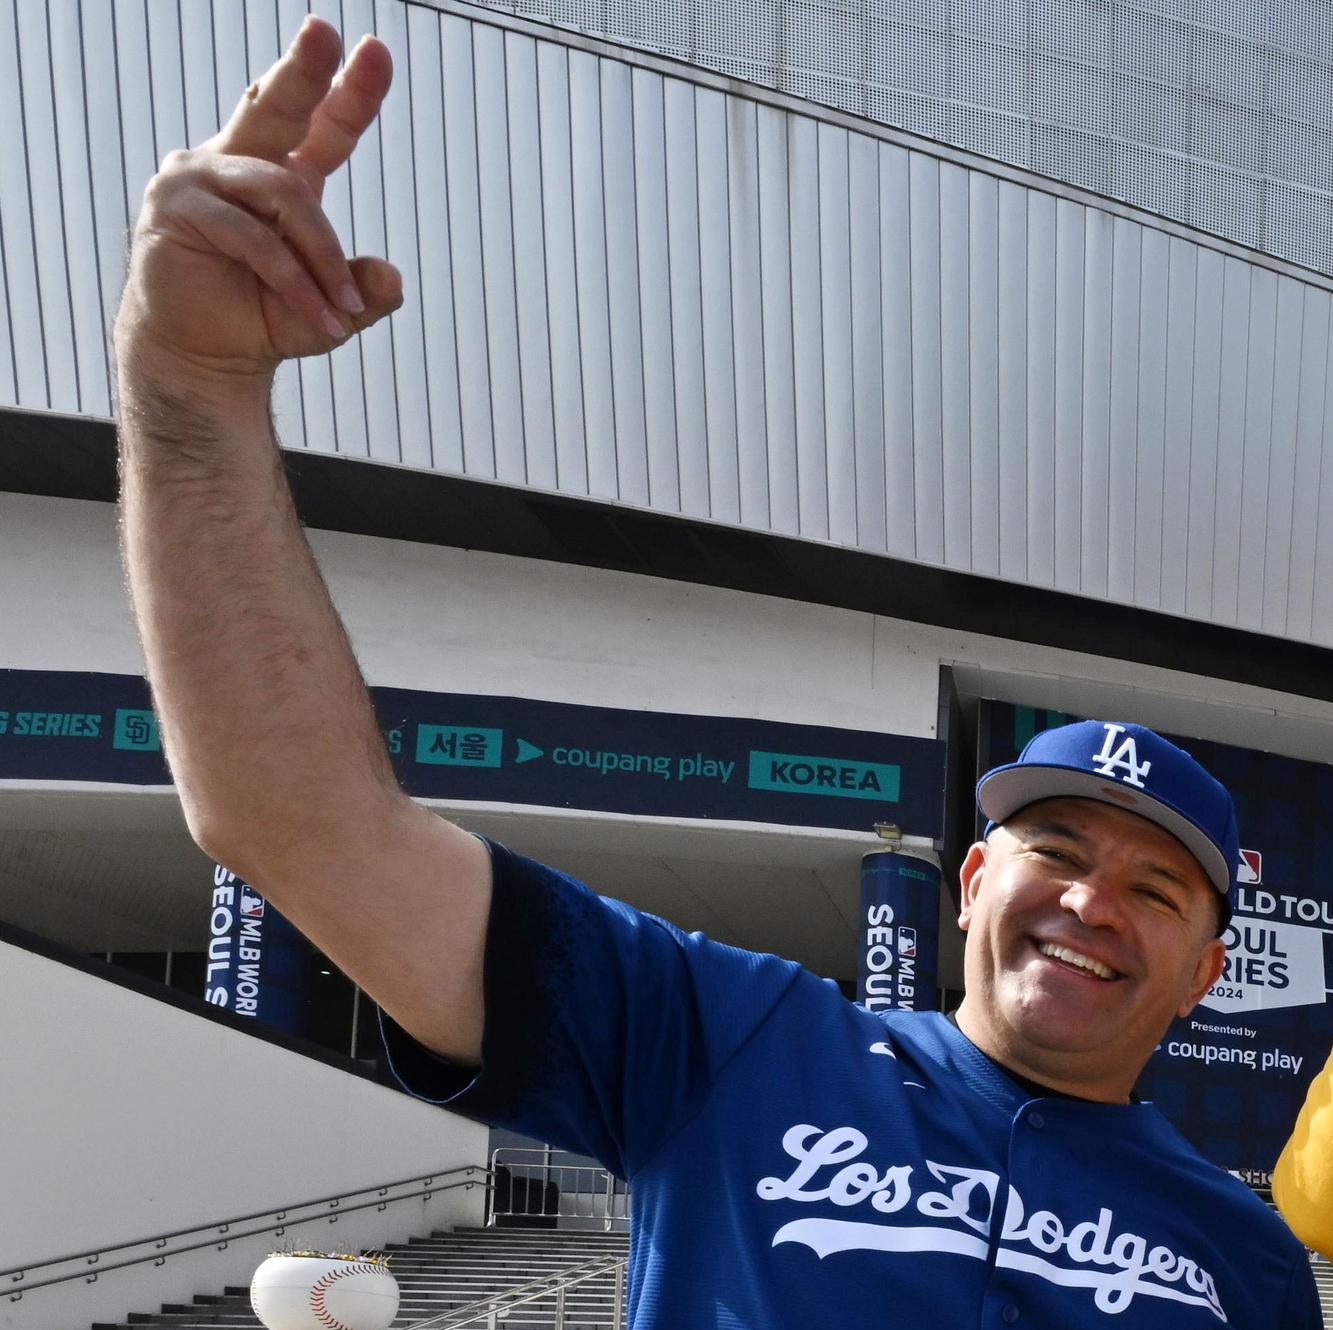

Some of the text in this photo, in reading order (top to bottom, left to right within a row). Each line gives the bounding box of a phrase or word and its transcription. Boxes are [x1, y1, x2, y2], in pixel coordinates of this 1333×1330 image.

[13, 712, 102, 737] SERIES
[429, 732, 489, 761] 서울
[552, 747, 672, 782] coupang
[678, 752, 735, 784] play
[770, 760, 881, 793] KOREA
[1092, 723, 1152, 788] LA
[206, 864, 236, 983] SEOUL
[238, 917, 263, 961] MLB
[865, 903, 894, 1013] SEOUL
[897, 957, 916, 996] MLB
[1207, 986, 1244, 1000] 2024
[1191, 1020, 1257, 1039] Presented by
[1168, 1041, 1303, 1075] coupang play
[757, 1123, 1226, 1315] Los Dodgers
